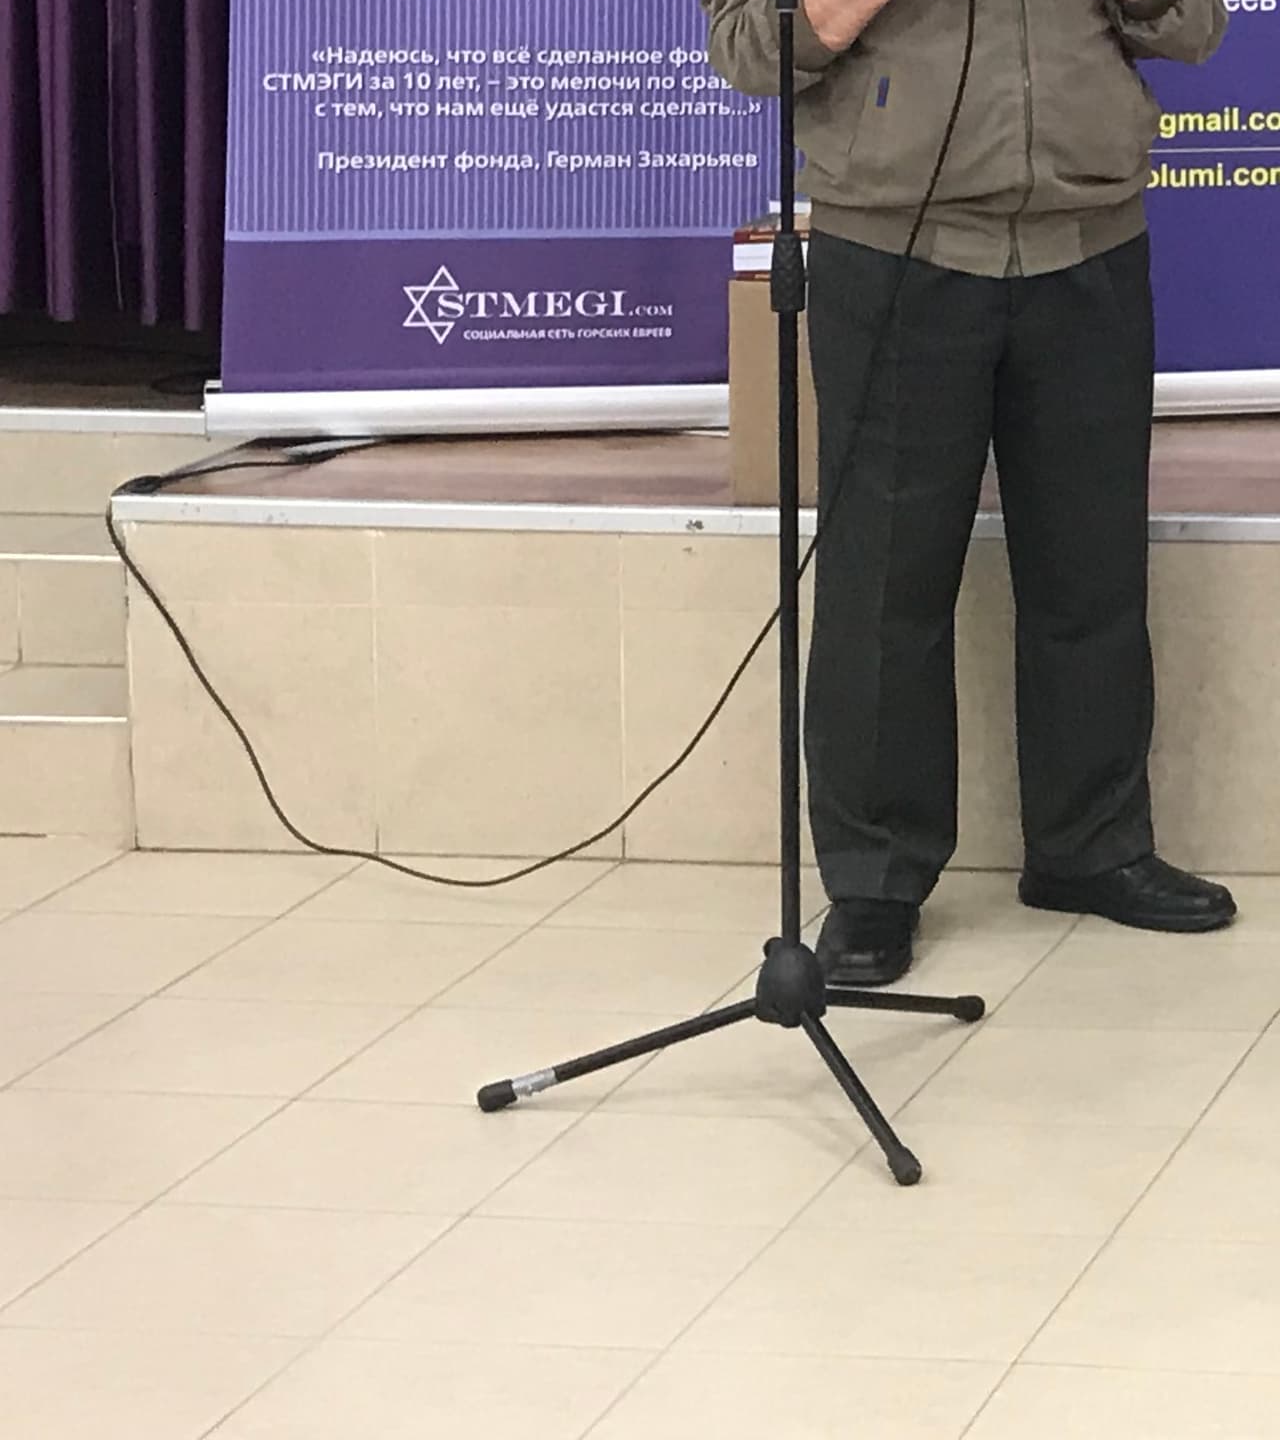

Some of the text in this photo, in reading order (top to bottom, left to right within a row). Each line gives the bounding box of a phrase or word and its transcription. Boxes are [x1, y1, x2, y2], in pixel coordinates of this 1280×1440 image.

[312, 46, 709, 68] «Надеюсь, что всё сделанное фо
[263, 73, 363, 92] СТМЭГИ
[369, 76, 396, 91] за
[402, 73, 431, 91] 10
[436, 76, 481, 93] лет,
[506, 76, 544, 91] это
[551, 76, 641, 90] мелочи
[647, 76, 675, 90] по
[315, 103, 326, 117] с
[331, 103, 383, 120] тем,
[389, 103, 429, 117] что
[436, 103, 484, 117] нам
[490, 98, 539, 119] ещё
[545, 102, 634, 120] удастся
[318, 150, 757, 173] Президент фонда, Герман Захарьяев
[463, 328, 546, 340] СОЦИАЛЬНАЯ
[547, 328, 575, 339] СЕТЬ
[577, 327, 630, 339] ГОРСКИХ
